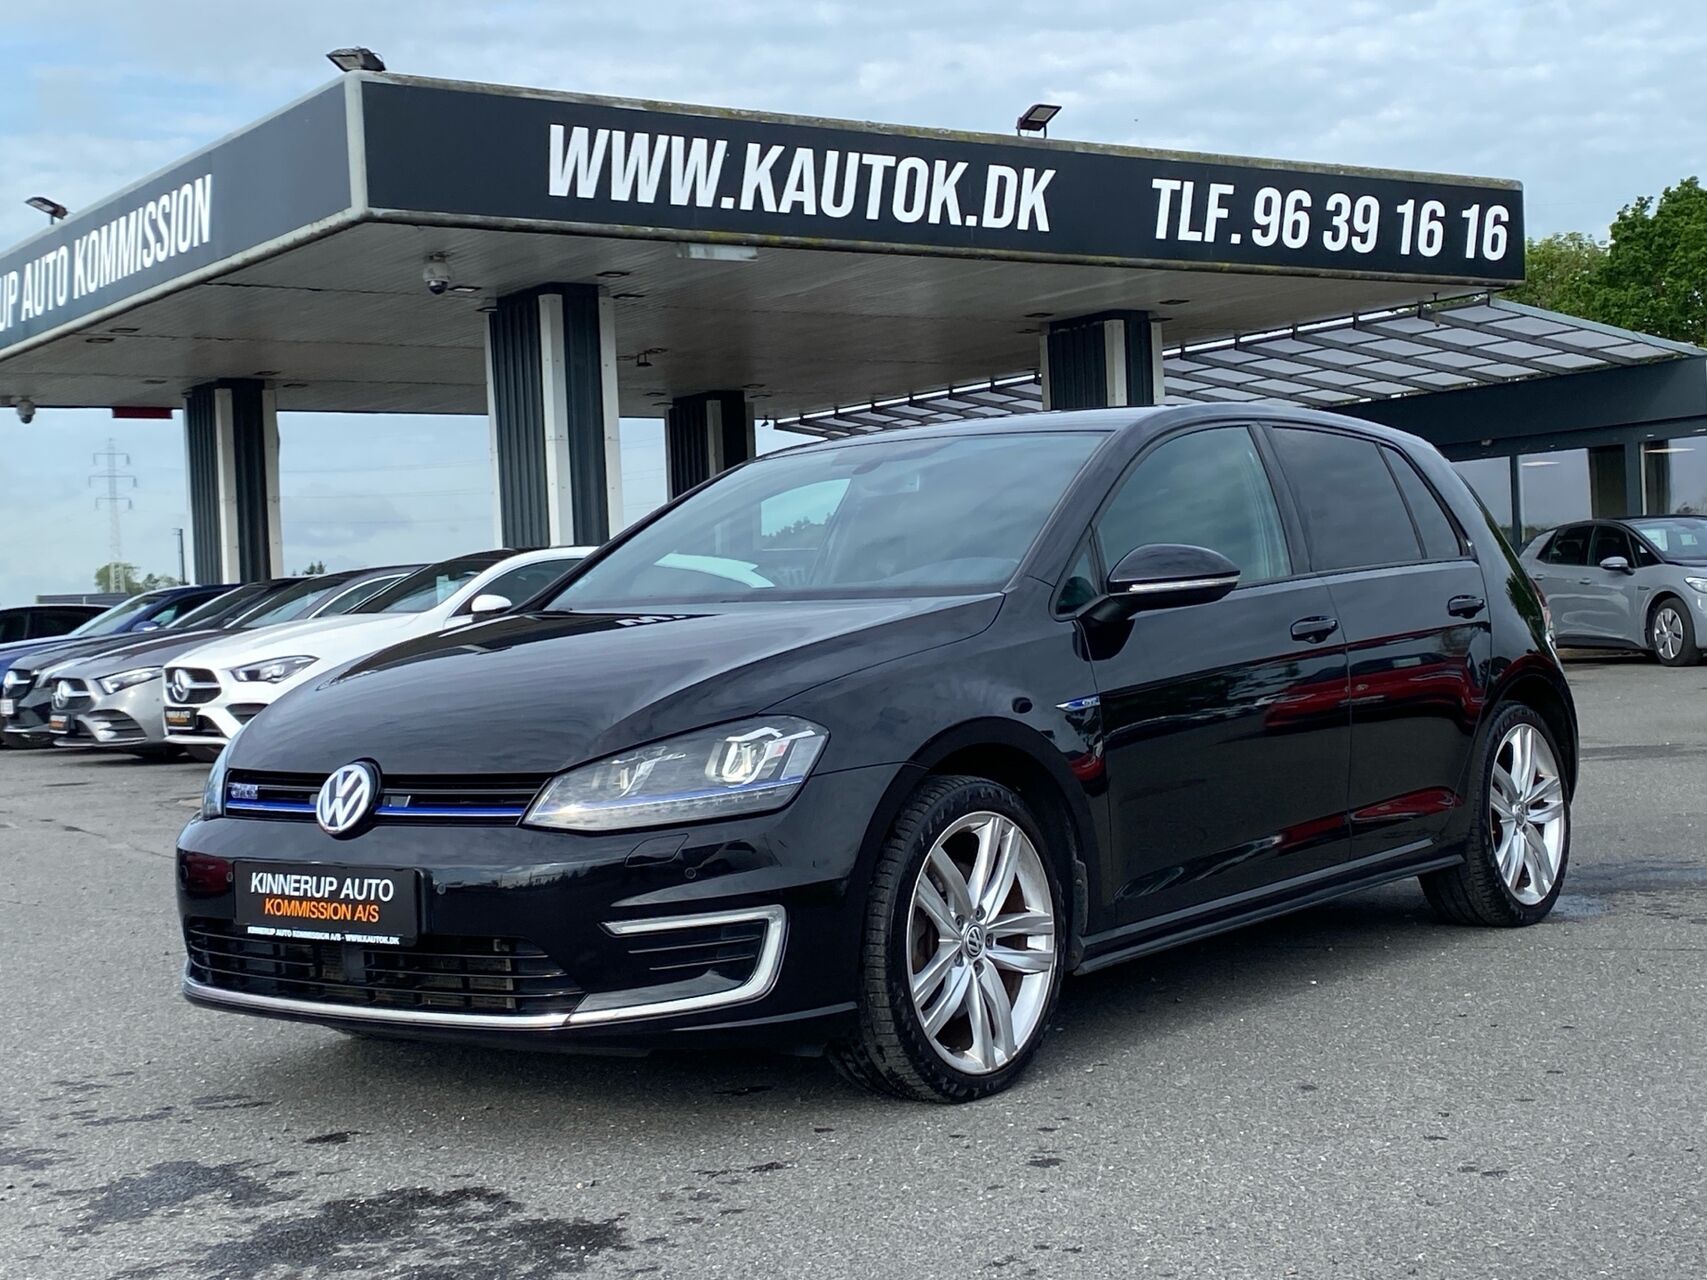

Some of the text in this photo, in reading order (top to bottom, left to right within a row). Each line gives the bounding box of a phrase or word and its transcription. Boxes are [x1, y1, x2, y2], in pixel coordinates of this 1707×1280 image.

[548, 124, 1056, 232] WWW.KAUTOK.DK
[1152, 178, 1510, 261] TLF. 96 39 16 16
[21, 245, 69, 322] AUTO
[73, 173, 212, 300] KOMMISSION
[250, 872, 394, 902] KINNERUP AUTO
[264, 898, 380, 923] KOMMISSION A/S
